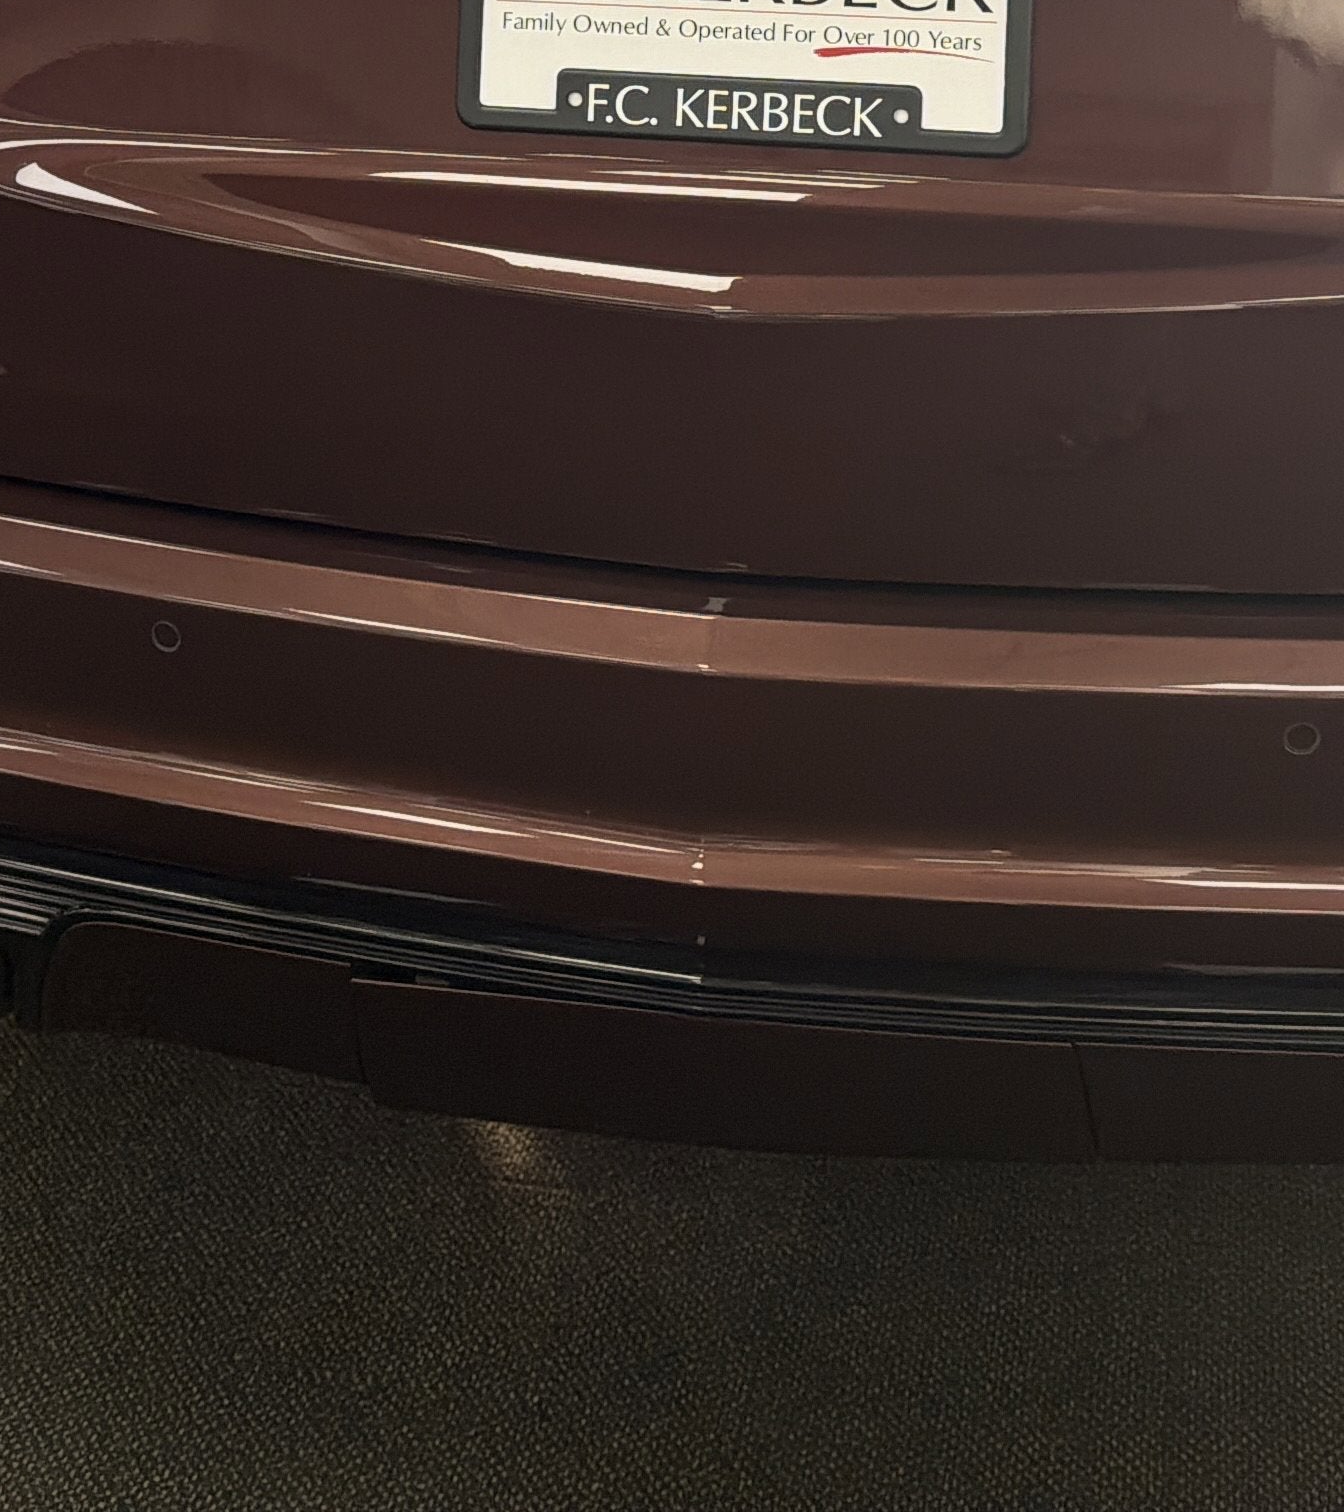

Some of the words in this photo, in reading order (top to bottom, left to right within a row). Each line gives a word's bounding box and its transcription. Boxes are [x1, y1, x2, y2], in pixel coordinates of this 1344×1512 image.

[502, 12, 567, 36] Family
[573, 14, 649, 36] Owned
[655, 20, 672, 37] &
[678, 18, 776, 43] Operated
[782, 24, 817, 44] For
[823, 25, 876, 46] Over
[883, 28, 920, 48] 100
[928, 30, 983, 51] Years
[586, 83, 659, 126] F.C.
[674, 87, 884, 138] KERBECK
